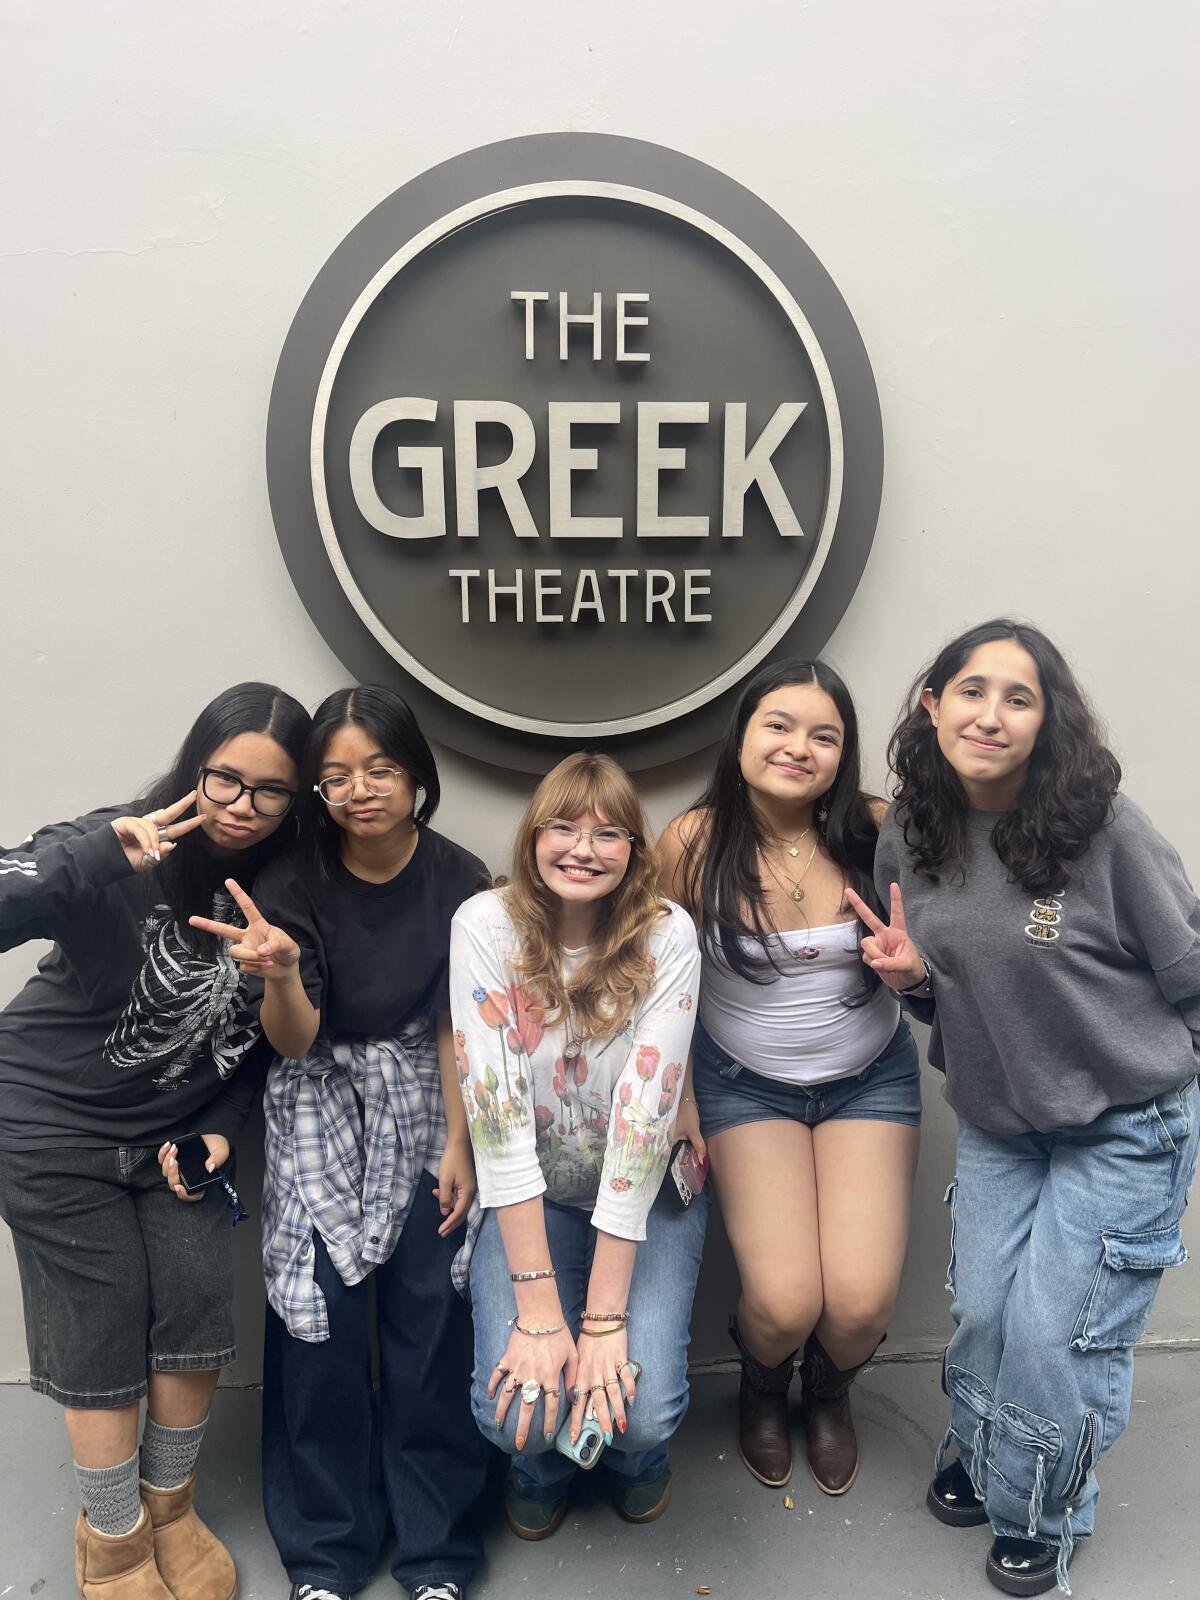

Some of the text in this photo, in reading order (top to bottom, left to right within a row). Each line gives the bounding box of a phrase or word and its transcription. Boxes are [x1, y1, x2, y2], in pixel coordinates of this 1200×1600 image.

[510, 290, 651, 362] THE
[348, 396, 809, 539] GREEK
[448, 569, 712, 623] THEATRE
